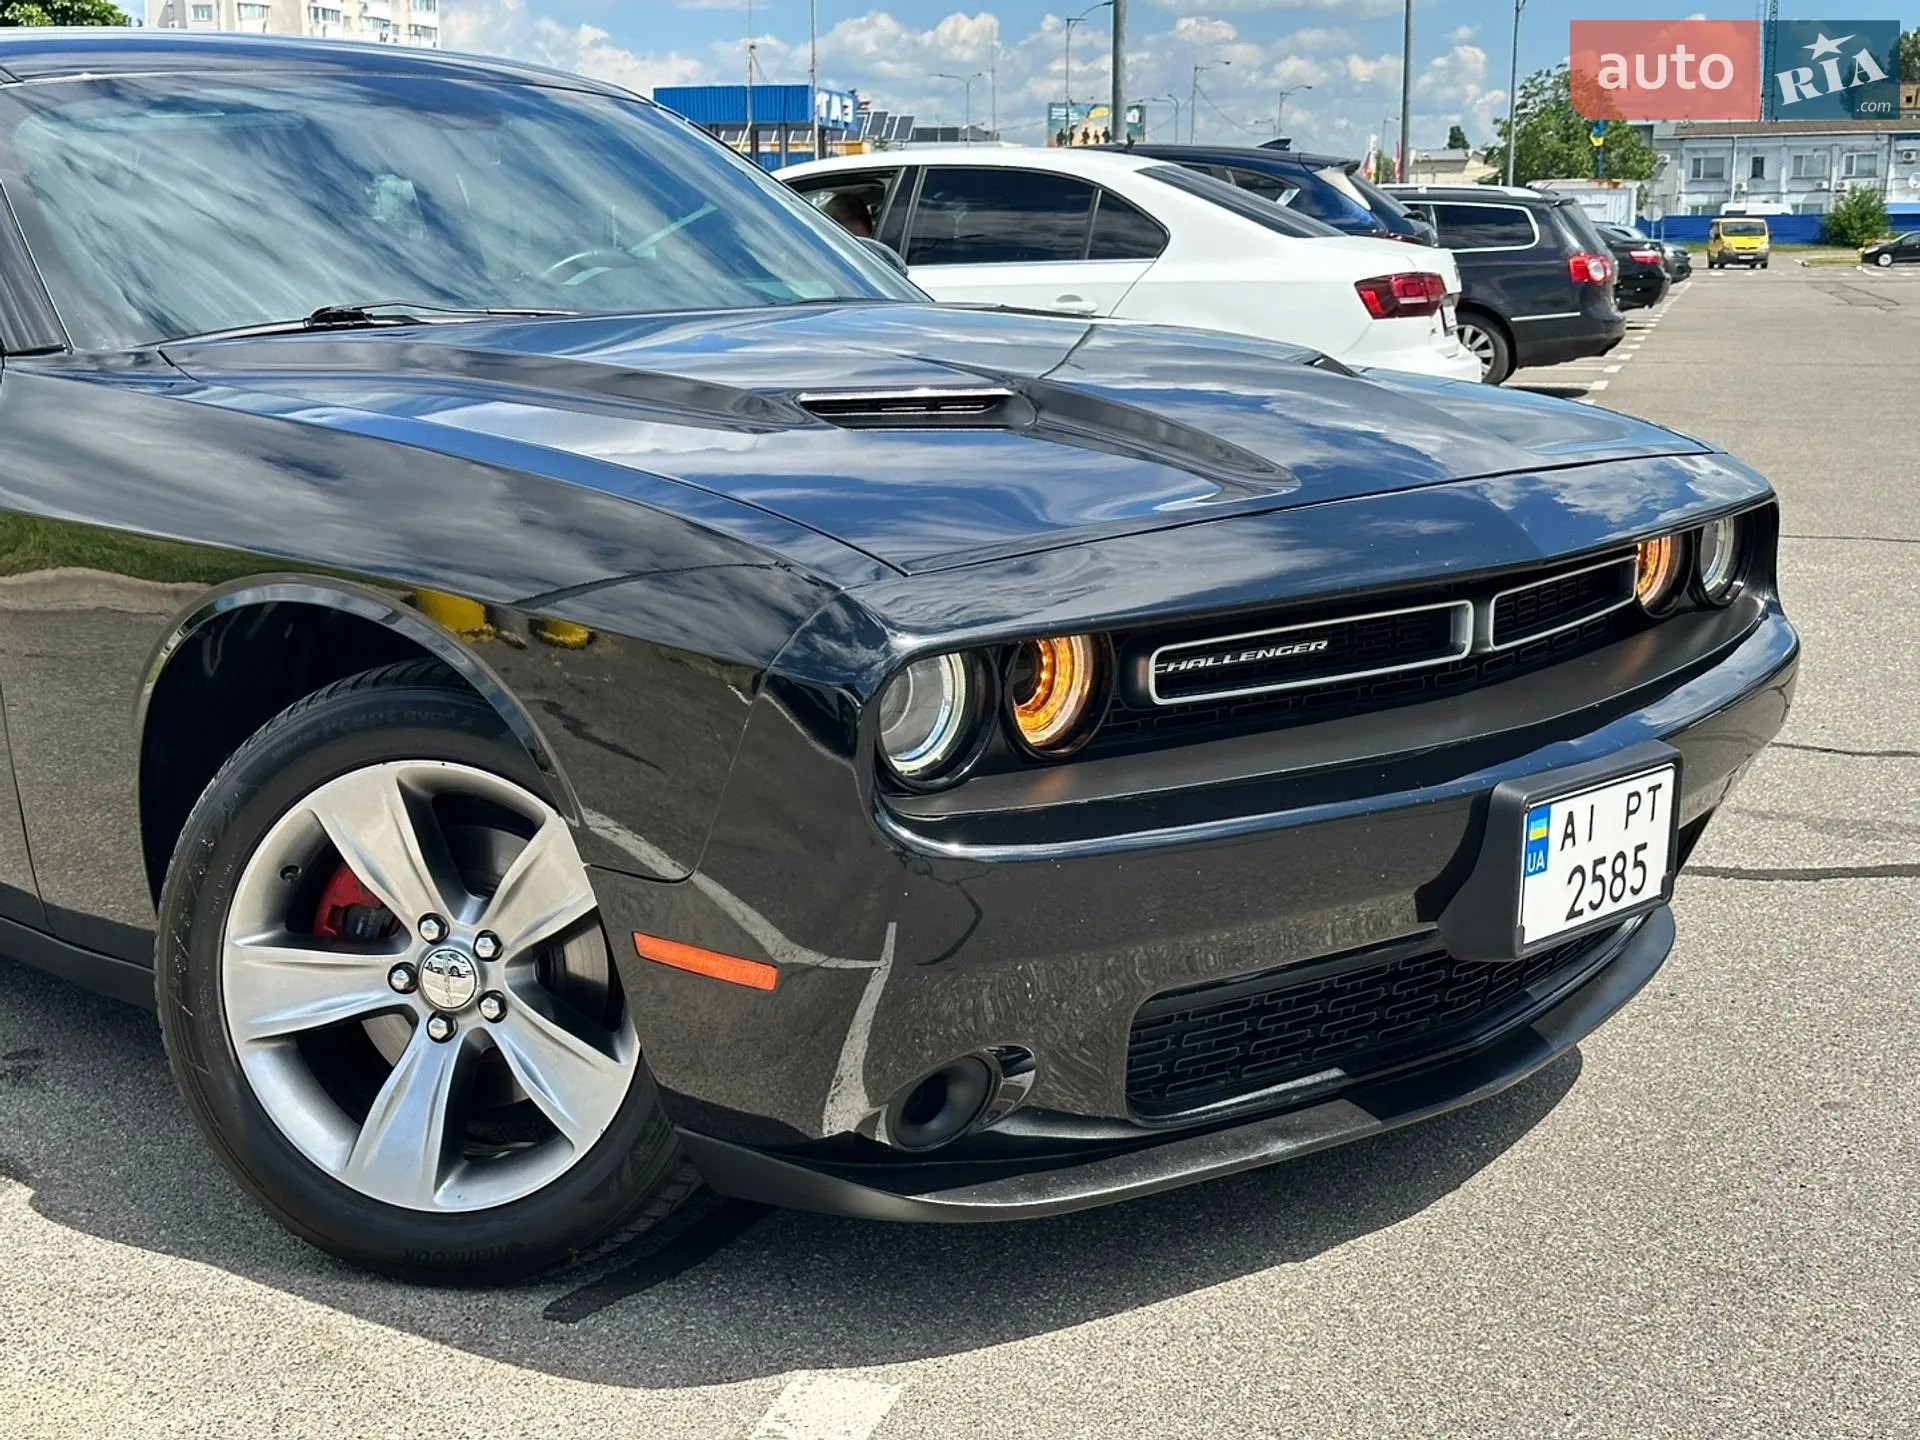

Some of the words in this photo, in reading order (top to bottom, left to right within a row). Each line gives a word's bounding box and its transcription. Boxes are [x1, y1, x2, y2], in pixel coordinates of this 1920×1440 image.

[1154, 639, 1329, 674] CHALLENGER
[1560, 803, 1595, 852] AI
[1624, 782, 1663, 831] PT
[1527, 850, 1546, 873] UA
[1565, 842, 1649, 922] 2585
